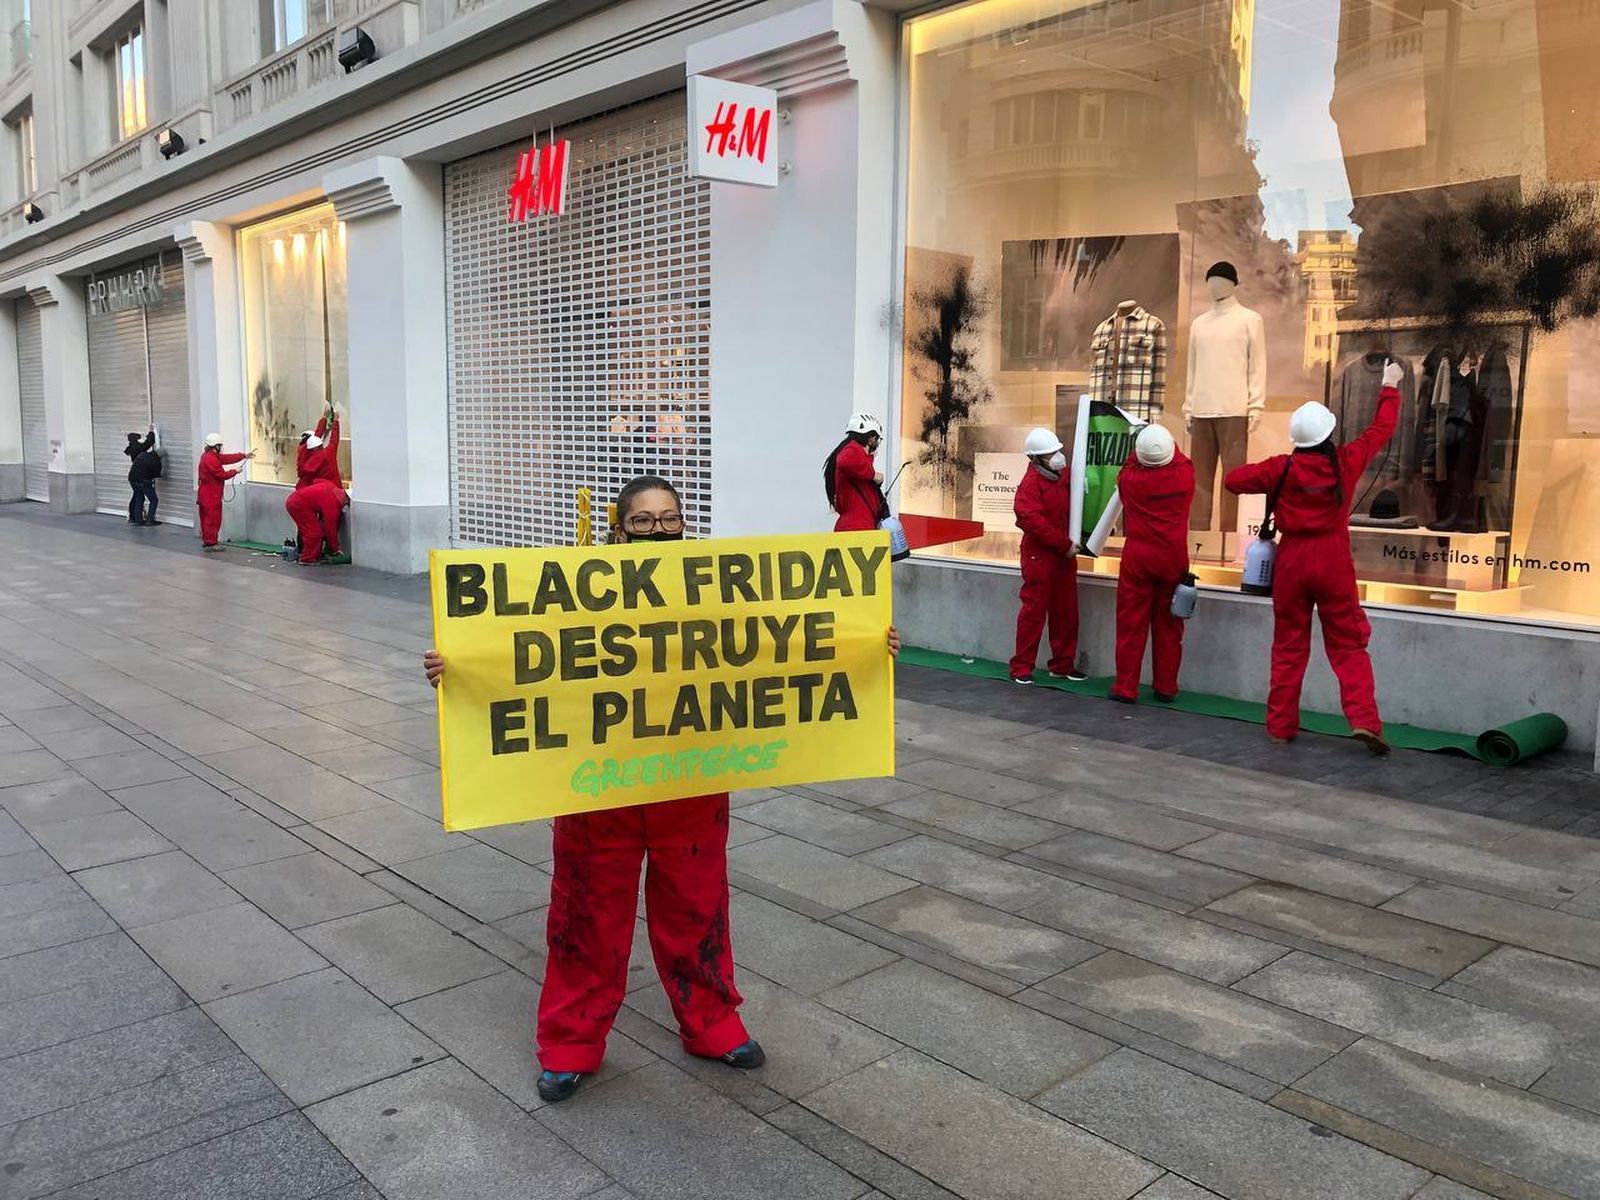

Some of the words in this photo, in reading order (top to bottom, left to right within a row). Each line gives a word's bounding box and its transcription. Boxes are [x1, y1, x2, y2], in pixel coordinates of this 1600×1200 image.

[705, 101, 771, 164] H&M
[509, 139, 570, 223] H&M
[88, 265, 160, 315] PRIMARK
[977, 483, 1019, 493] Crewnec
[992, 471, 1010, 480] The
[445, 558, 667, 617] BLACK
[683, 546, 889, 605] FRIDAY
[1383, 545, 1416, 560] Más
[1421, 550, 1479, 565] estilos
[1485, 556, 1506, 567] en
[1513, 554, 1590, 573] hm.com
[513, 611, 836, 685] DESTRUYE
[490, 697, 568, 755] EL
[591, 672, 858, 745] PLANETA
[570, 739, 788, 797] GREENPEACE
